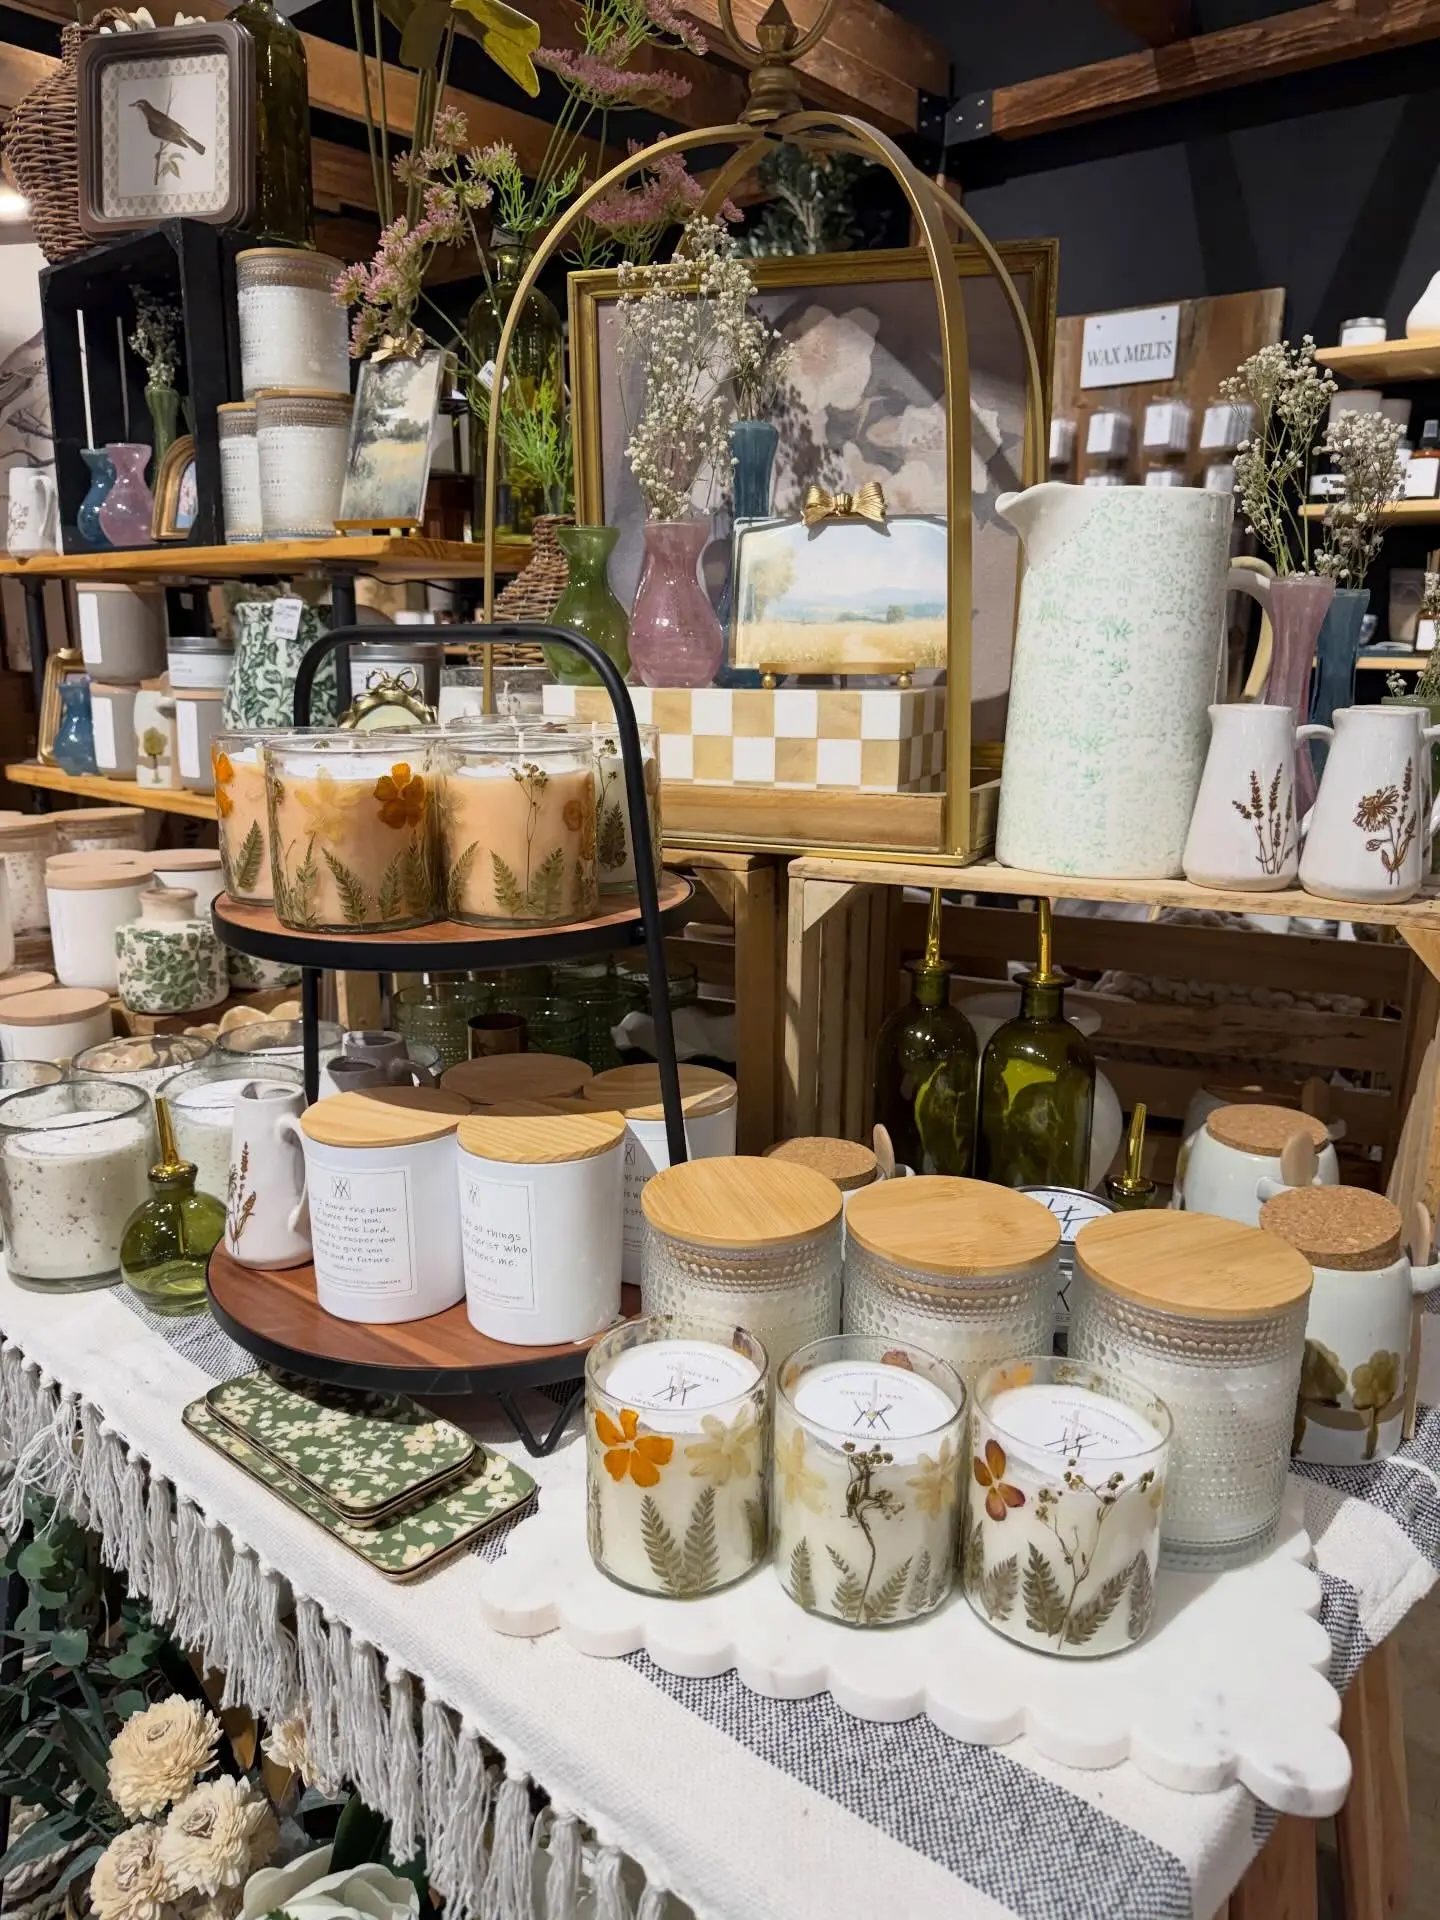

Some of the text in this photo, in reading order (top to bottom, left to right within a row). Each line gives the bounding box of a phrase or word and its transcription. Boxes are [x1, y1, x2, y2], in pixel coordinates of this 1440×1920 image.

[1087, 340, 1173, 367] WAX MELTS
[369, 1205, 398, 1216] plans
[345, 1214, 358, 1222] for
[339, 1235, 375, 1245] prosper
[378, 1235, 397, 1245] you
[487, 1229, 521, 1243] things
[504, 1244, 528, 1254] who
[498, 1258, 519, 1268] me.
